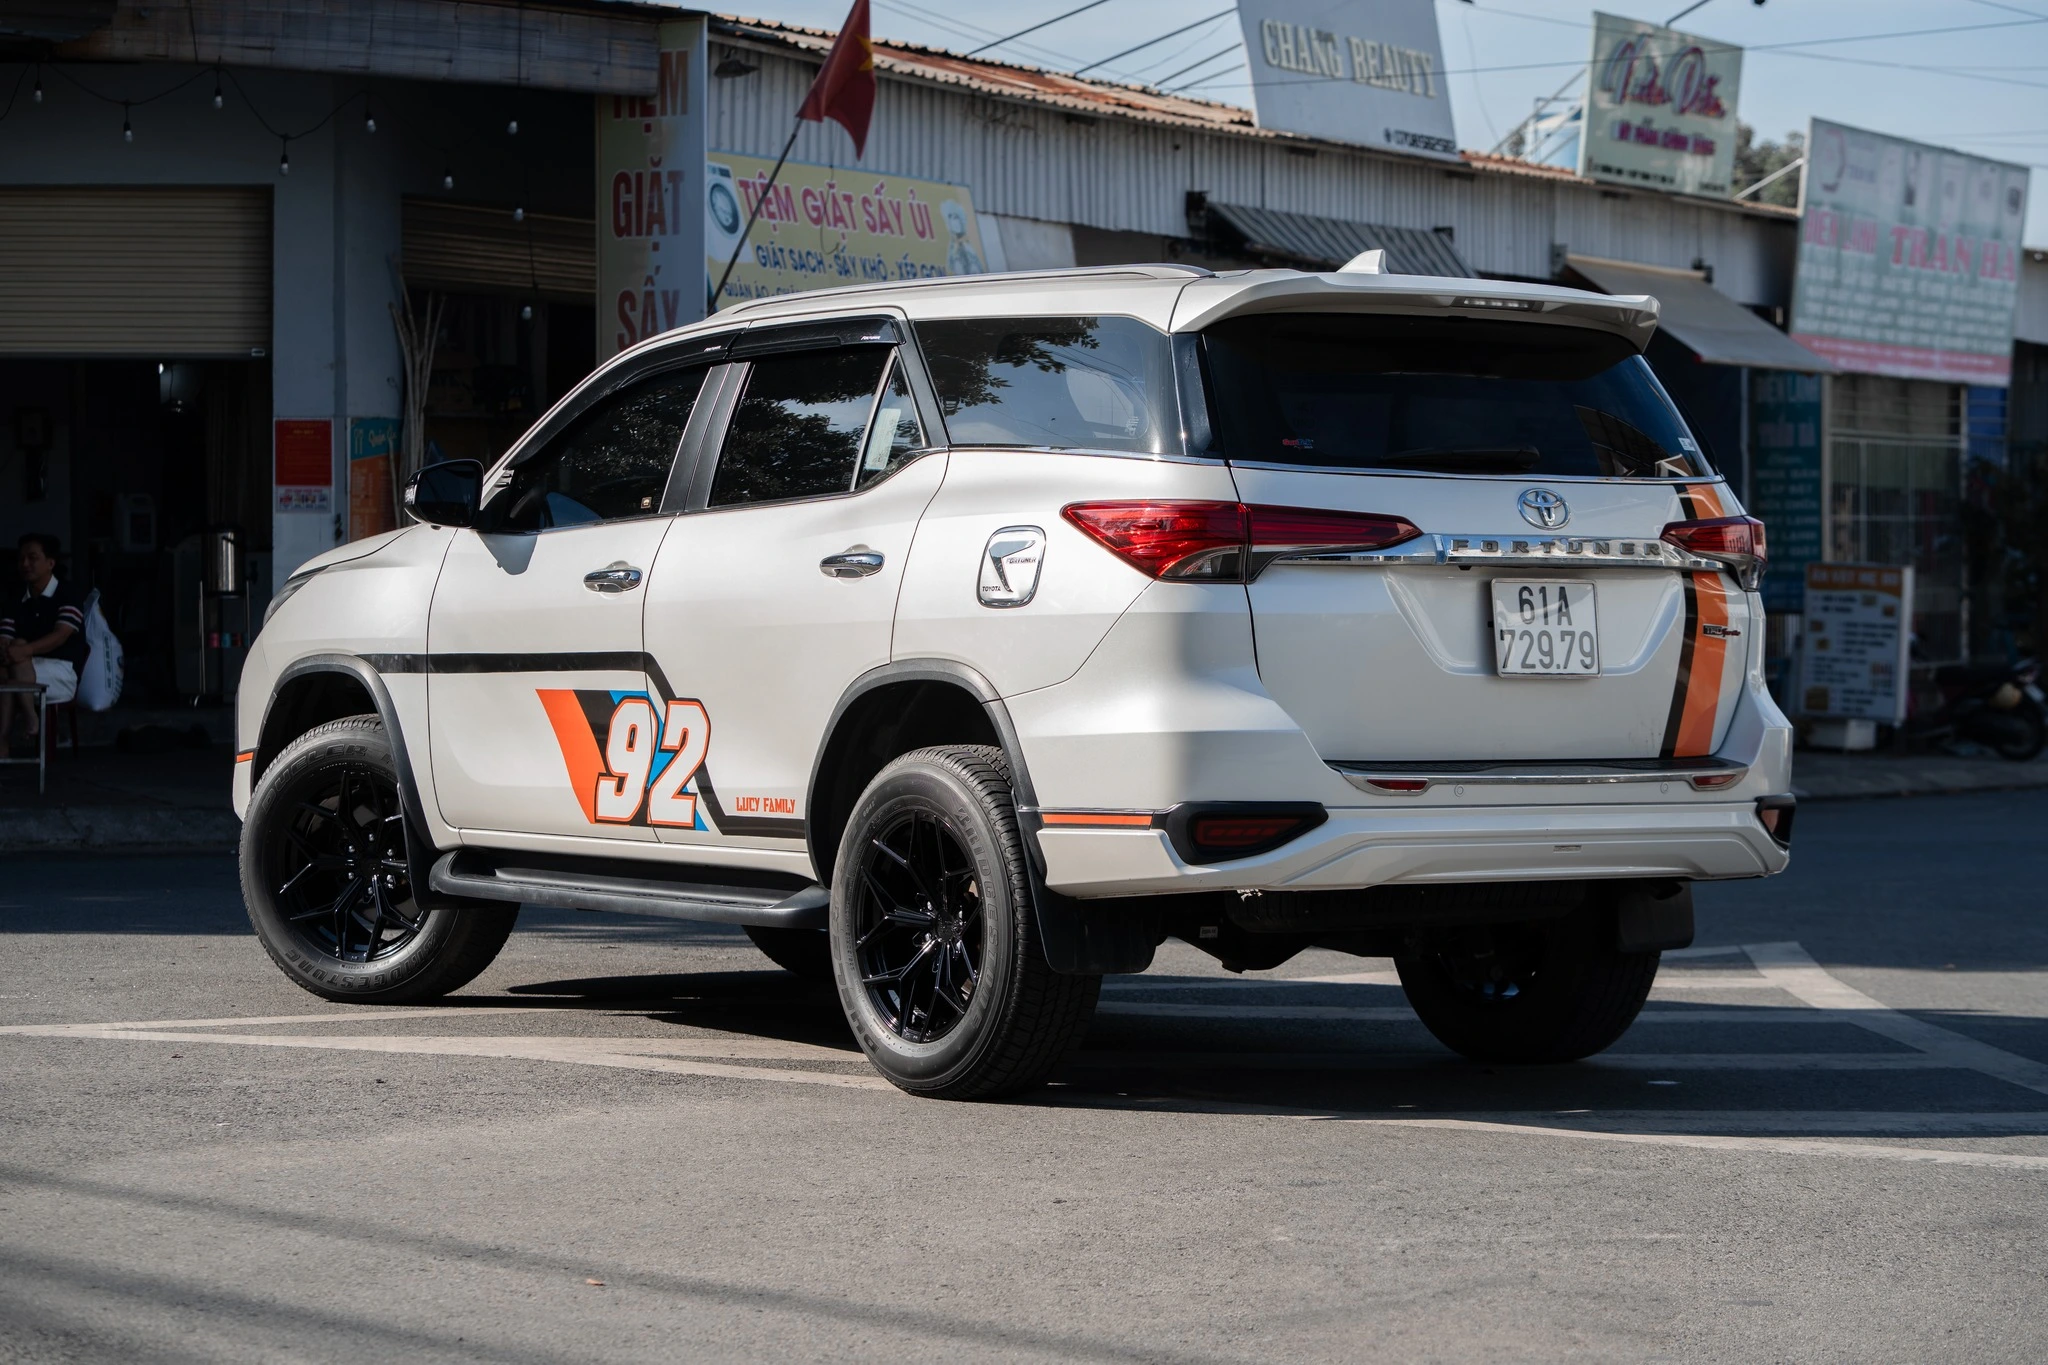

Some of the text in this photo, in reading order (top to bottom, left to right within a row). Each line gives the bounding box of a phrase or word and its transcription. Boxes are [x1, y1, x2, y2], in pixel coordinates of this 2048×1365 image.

[1260, 18, 1438, 98] CHANG BEAUTY
[612, 156, 685, 252] GIẶT
[738, 169, 935, 240] TIỆM GIẶT SẤY ỦI
[756, 241, 786, 275] GIẶT
[789, 248, 824, 279] SẠCH
[861, 253, 887, 280] KHÔ
[616, 264, 681, 351] SẤY
[1451, 538, 1660, 556] FORTUNER
[1518, 586, 1572, 626] 61A
[1500, 629, 1596, 670] 729.79
[262, 744, 367, 816] DUELER
[595, 699, 711, 827] 92
[736, 797, 796, 814] LUCY FAMILY
